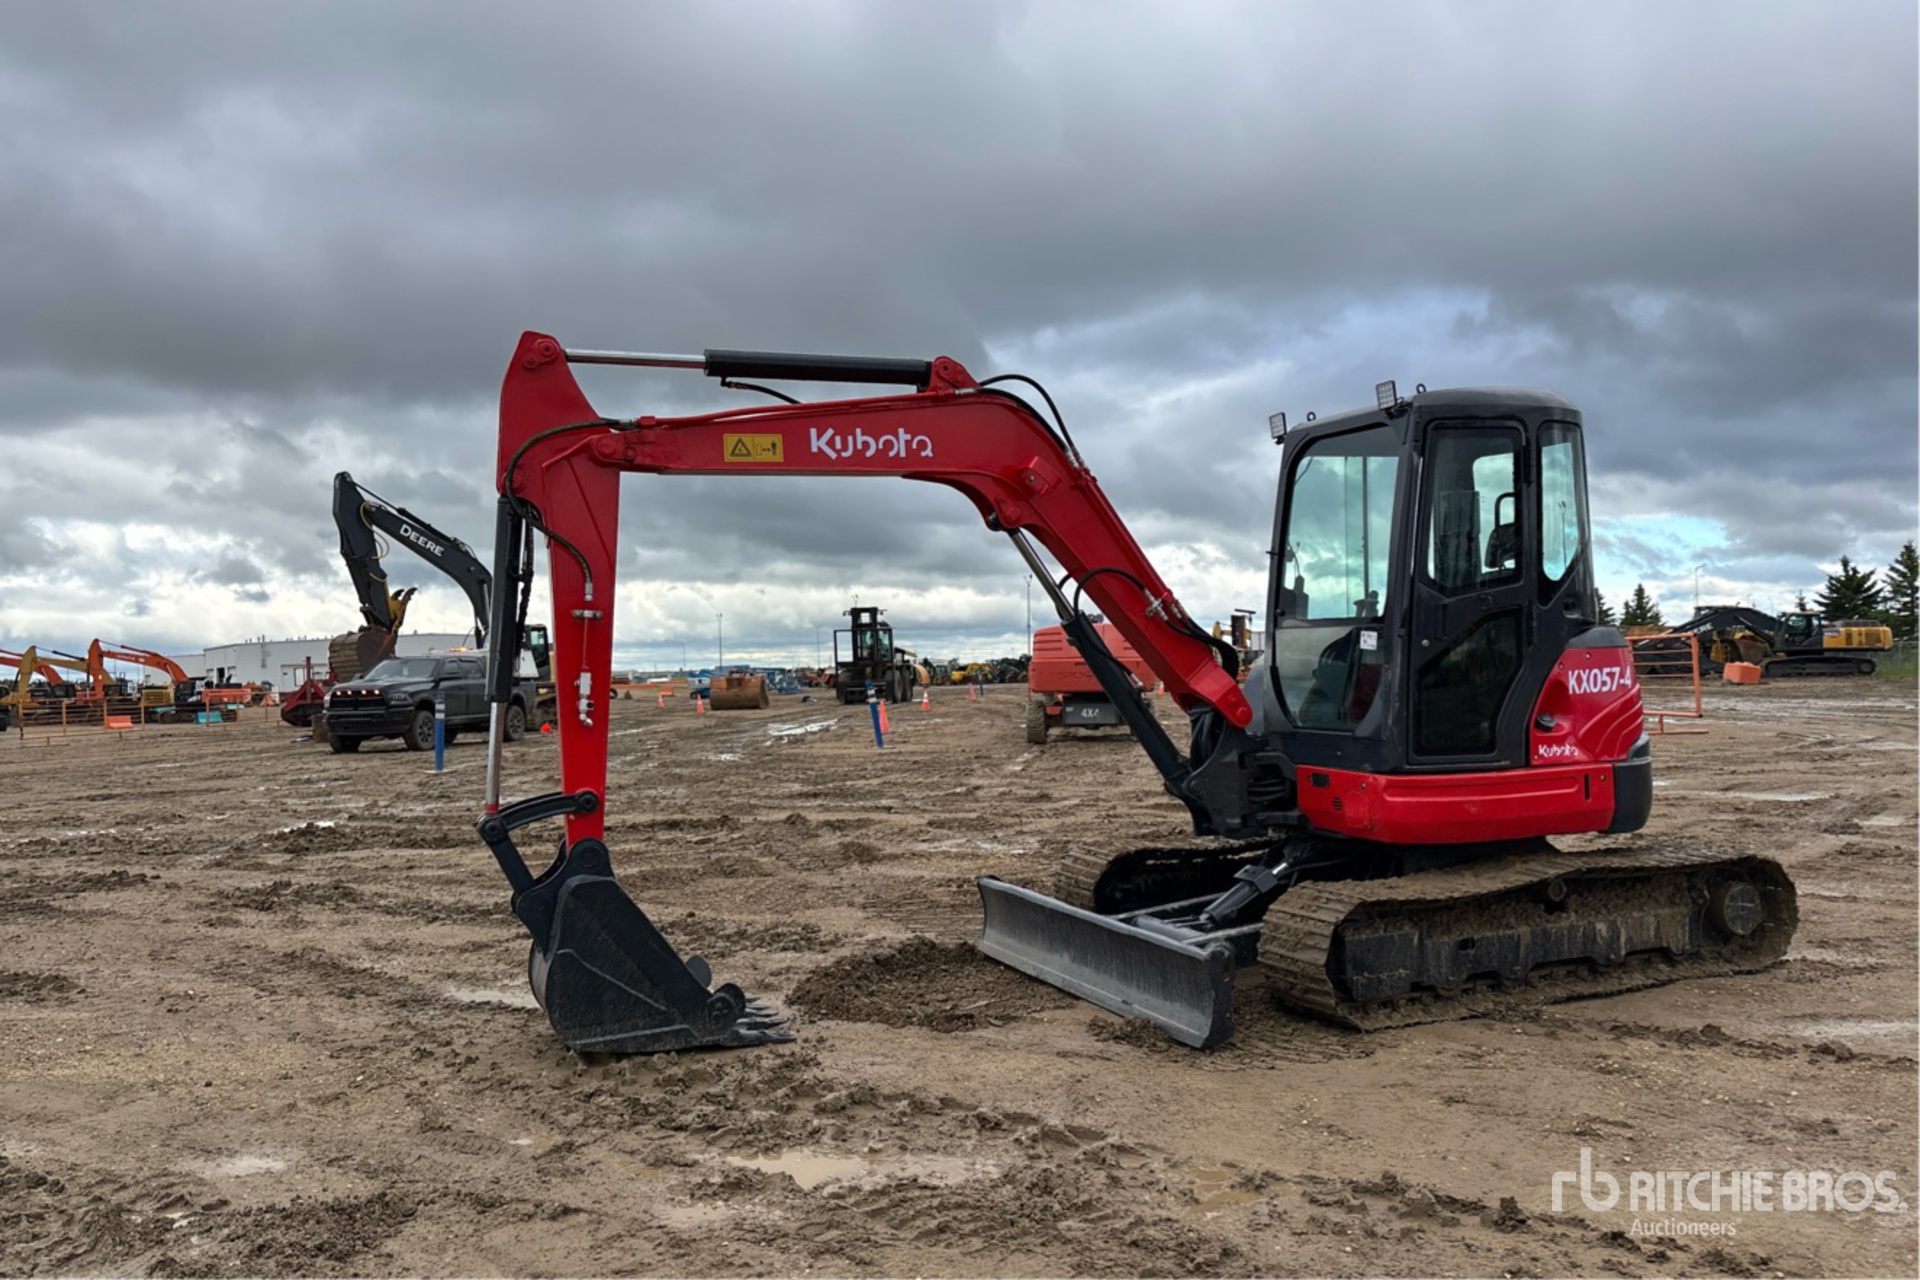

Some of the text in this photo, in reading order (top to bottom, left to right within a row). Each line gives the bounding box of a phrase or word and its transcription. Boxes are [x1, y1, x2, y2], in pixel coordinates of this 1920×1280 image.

[809, 427, 933, 460] Kubota
[400, 523, 445, 557] DEERE
[1568, 666, 1632, 695] KX057-4
[1538, 744, 1579, 757] Kubota
